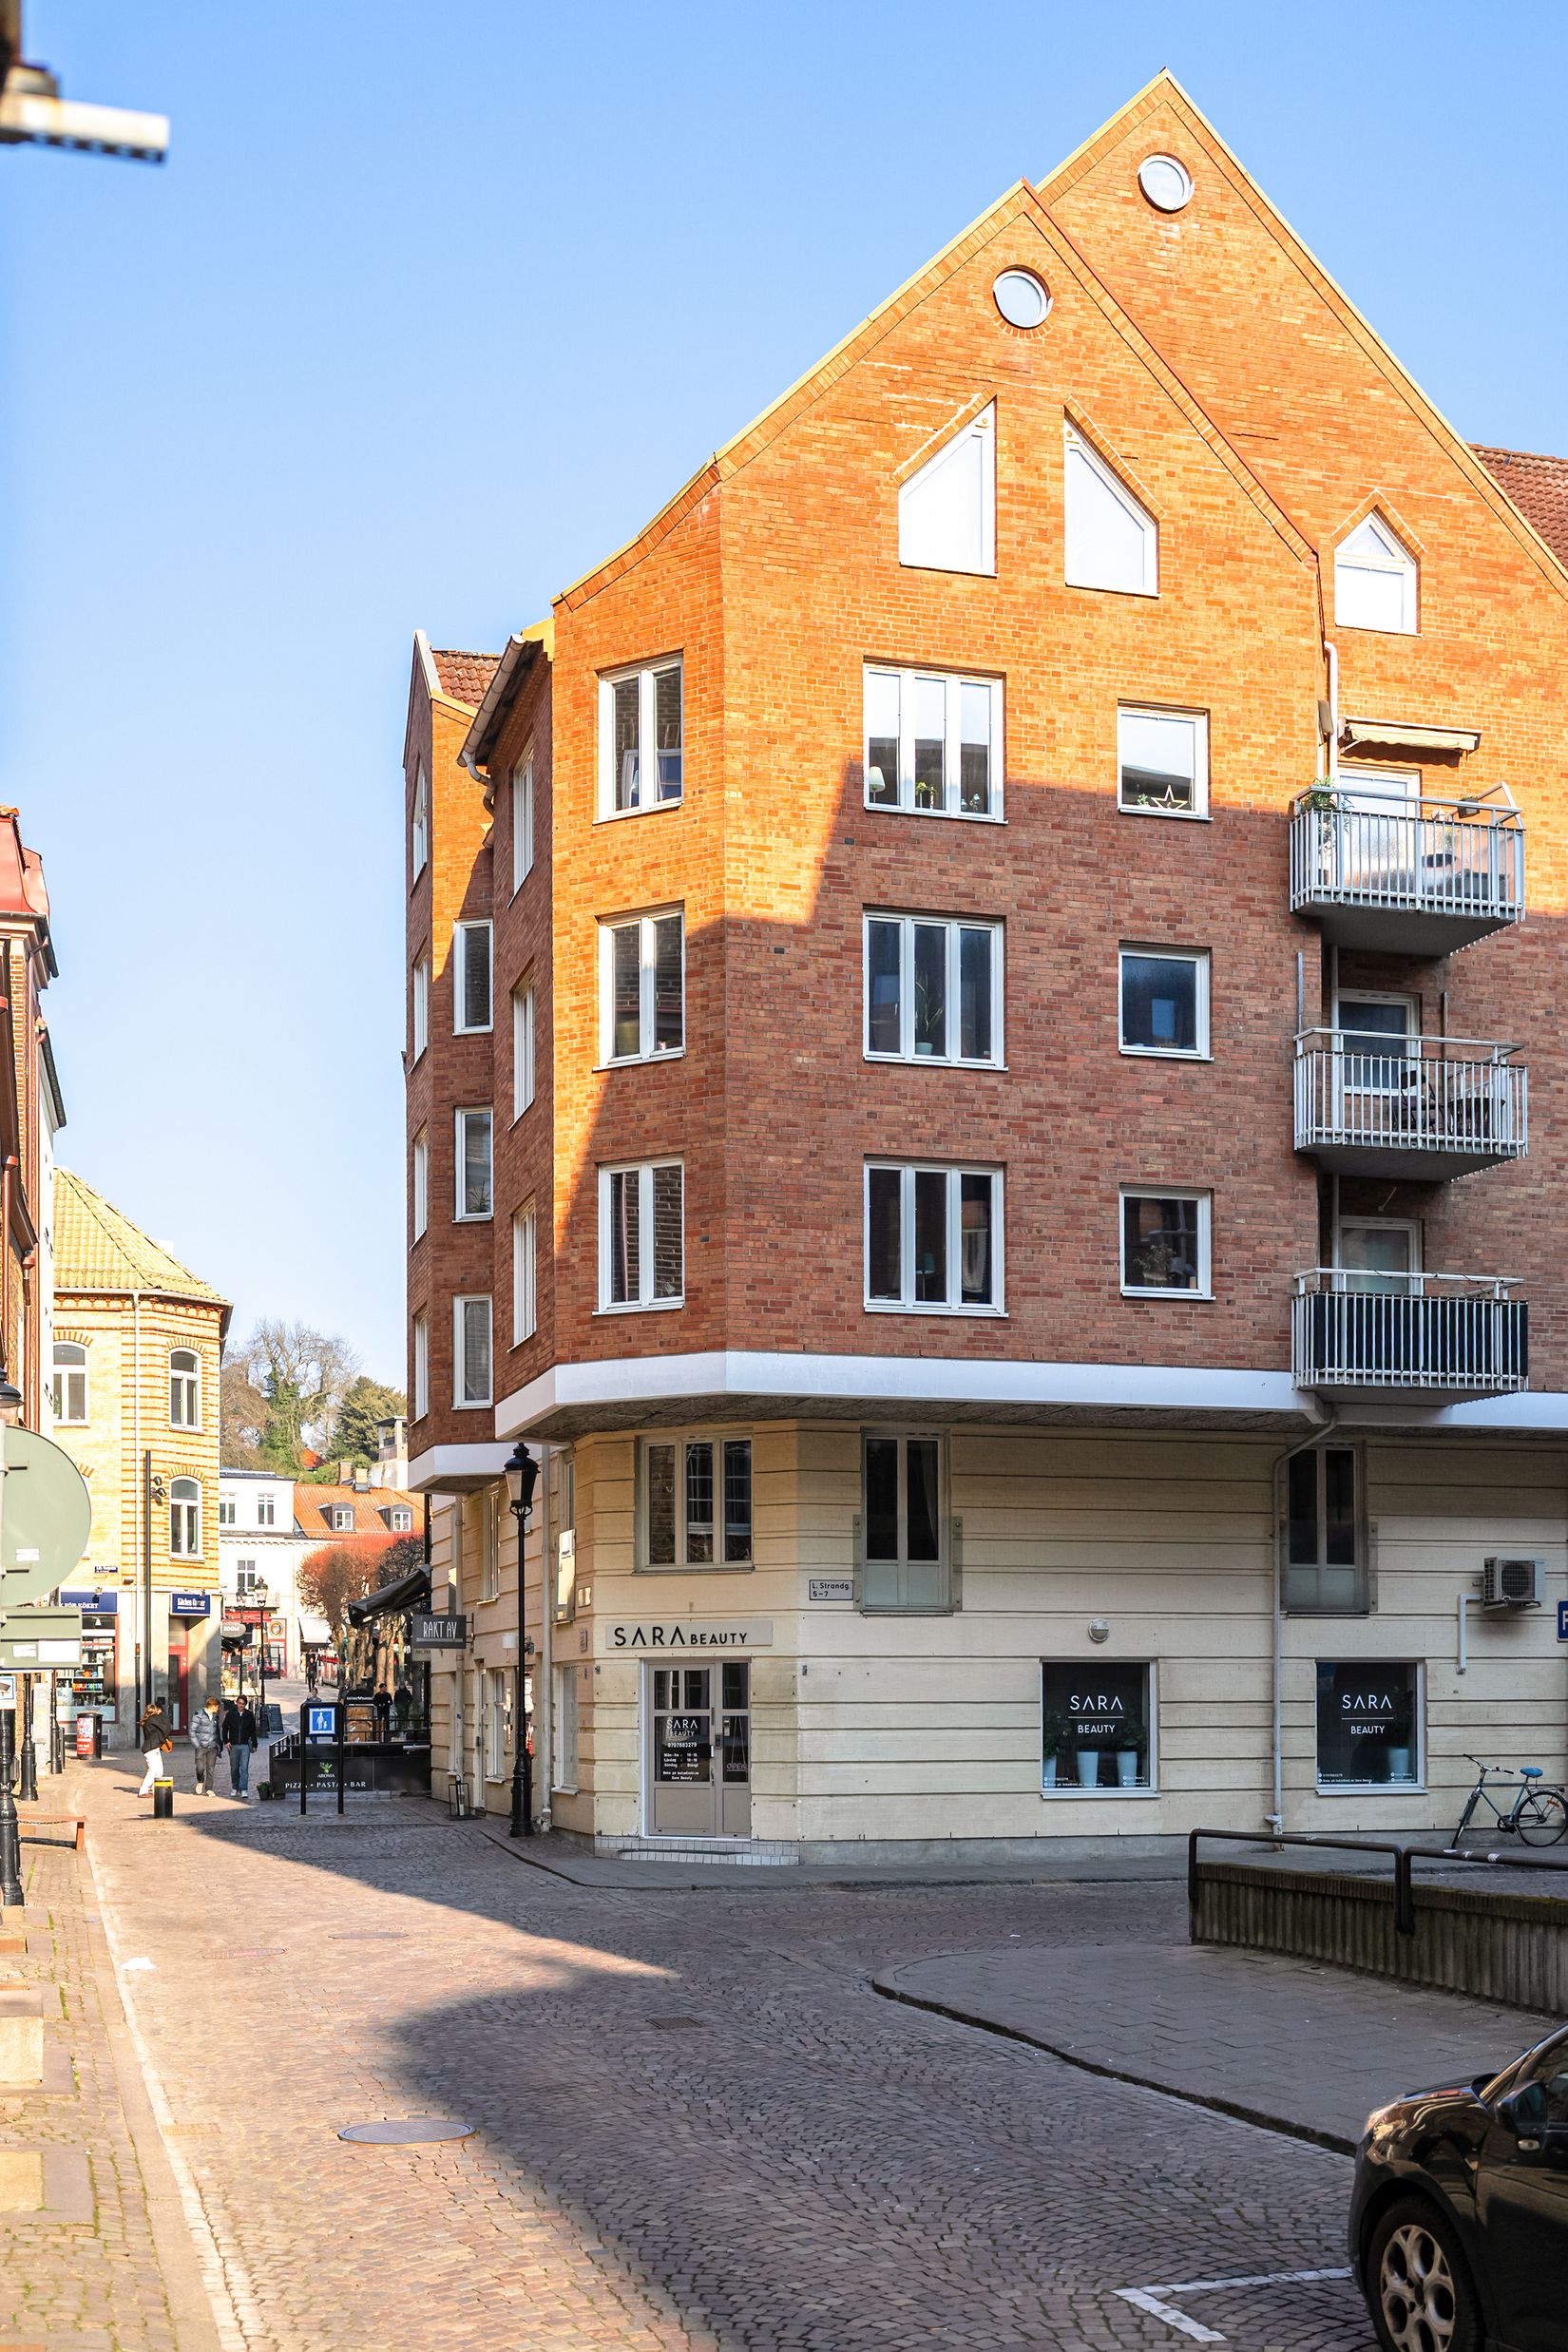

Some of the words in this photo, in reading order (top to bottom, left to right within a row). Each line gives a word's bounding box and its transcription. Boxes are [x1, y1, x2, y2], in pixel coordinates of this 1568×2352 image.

[820, 1582, 851, 1591] Strandg.
[423, 1621, 445, 1638] RAKT
[447, 1621, 457, 1640] AV
[614, 1626, 686, 1646] SARA
[690, 1633, 748, 1645] BEAUTY
[1070, 1695, 1123, 1711] SARA
[1342, 1694, 1392, 1710] SARA
[666, 1719, 698, 1729] SARA
[1078, 1725, 1116, 1733] BEAUTY
[1350, 1726, 1386, 1734] BEAUTY
